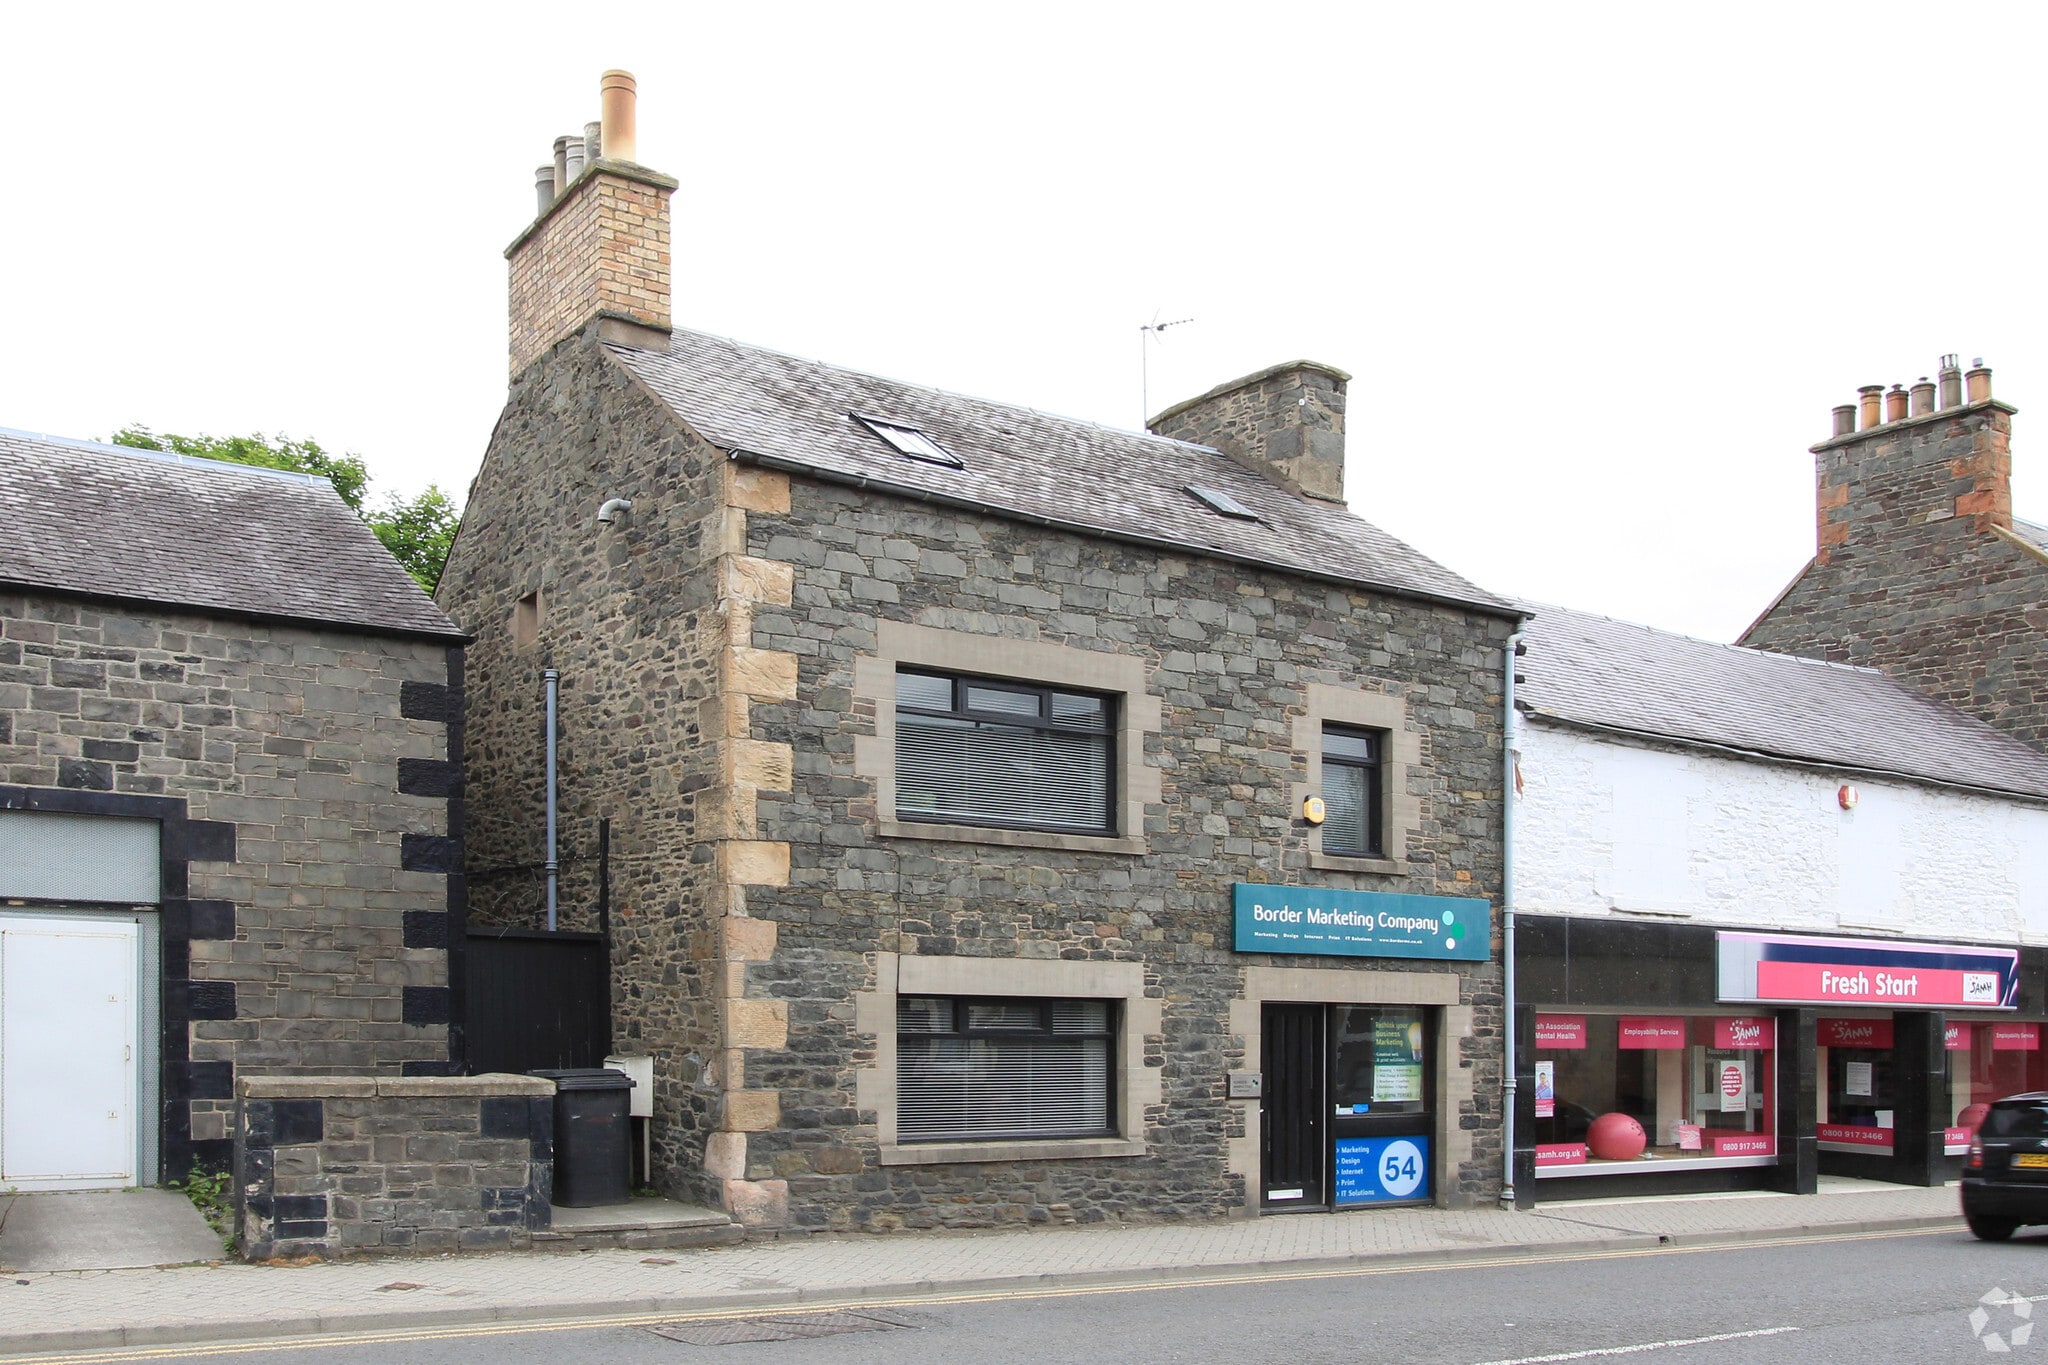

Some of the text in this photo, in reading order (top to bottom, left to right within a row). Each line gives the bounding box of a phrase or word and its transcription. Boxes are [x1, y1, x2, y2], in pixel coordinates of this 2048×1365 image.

[1253, 904, 1438, 935] Border Marketing Company
[1254, 931, 1278, 939] Marketing
[1283, 932, 1299, 940] Design
[1821, 970, 1918, 996] Fresh Start
[1969, 982, 1992, 995] SAMH
[1546, 1022, 1580, 1031] Association
[1535, 1031, 1556, 1039] Mental
[1624, 1028, 1679, 1037] Employability Service
[1732, 1024, 1760, 1041] SAMH
[1834, 1025, 1873, 1041] SAMH
[1945, 1027, 1958, 1040] MH
[1375, 1038, 1404, 1047] Marketing
[1822, 1129, 1883, 1140] 0800 917 3466
[1341, 1146, 1370, 1154] Marketing
[1722, 1141, 1767, 1151] 0800 917 3466
[1535, 1150, 1581, 1159] .samh.org.uk
[1341, 1158, 1360, 1166] Design
[1384, 1155, 1417, 1182] 54
[1348, 1189, 1375, 1197] Solutions
